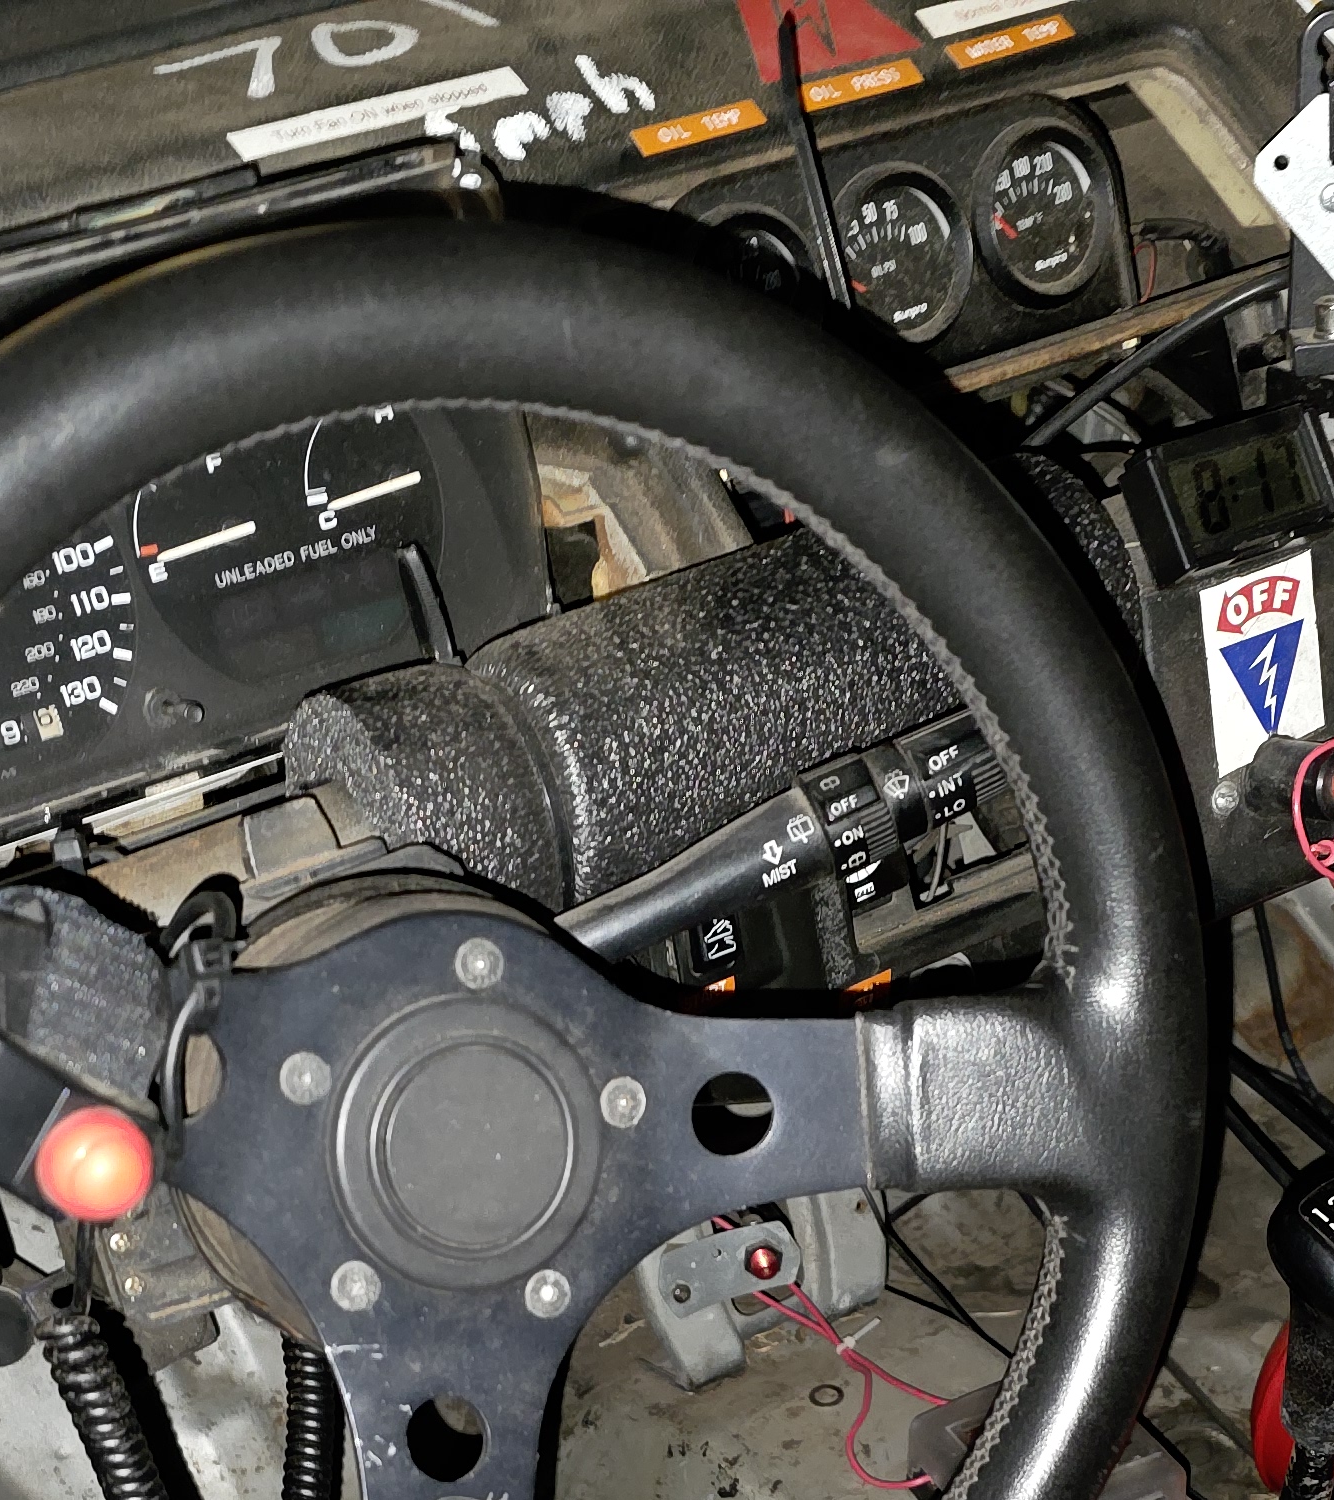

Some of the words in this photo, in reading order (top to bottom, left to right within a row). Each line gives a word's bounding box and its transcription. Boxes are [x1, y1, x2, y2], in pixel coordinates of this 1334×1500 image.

[1022, 20, 1059, 42] TEMP
[808, 83, 842, 103] OIL
[850, 67, 901, 92] PRESS
[350, 108, 378, 125] ON
[656, 124, 692, 144] OIL
[701, 107, 742, 132] TEMP
[861, 201, 878, 225] 50
[882, 199, 899, 221] 75
[907, 222, 928, 246] 100
[205, 452, 222, 474] F
[318, 510, 338, 531] C
[52, 542, 95, 575] 100
[215, 551, 295, 588] UNLEADED
[300, 538, 338, 563] FUEL
[341, 525, 377, 550] ONLY
[148, 561, 168, 583] E
[70, 586, 110, 616] 110
[1226, 580, 1294, 626] OFF
[33, 605, 57, 624] 180
[25, 642, 55, 663] 200
[70, 629, 112, 661] 120
[11, 676, 39, 697] 220
[60, 675, 102, 707] 130
[928, 745, 959, 773] OFF
[937, 771, 963, 798] INT
[830, 794, 858, 817] OFF
[944, 798, 966, 817] LO
[841, 825, 865, 846] ON
[762, 859, 797, 888] MIST
[1311, 1207, 1330, 1222] 1
